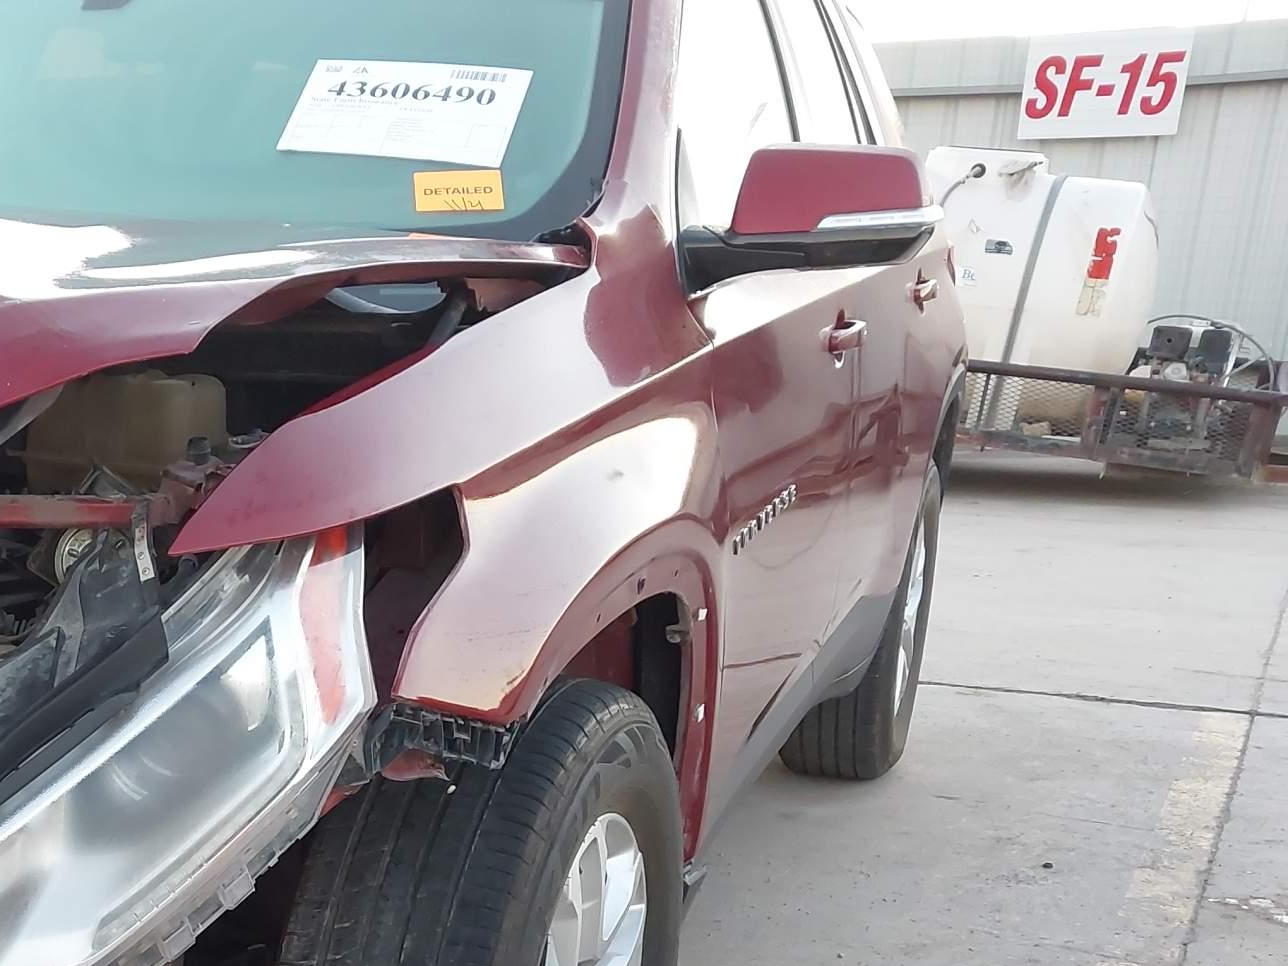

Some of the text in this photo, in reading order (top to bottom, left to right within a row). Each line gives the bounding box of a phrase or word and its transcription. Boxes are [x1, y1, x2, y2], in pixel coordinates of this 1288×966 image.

[327, 79, 497, 106] 43606490
[1025, 50, 1187, 119] SF-15
[423, 186, 494, 196] DETAILED
